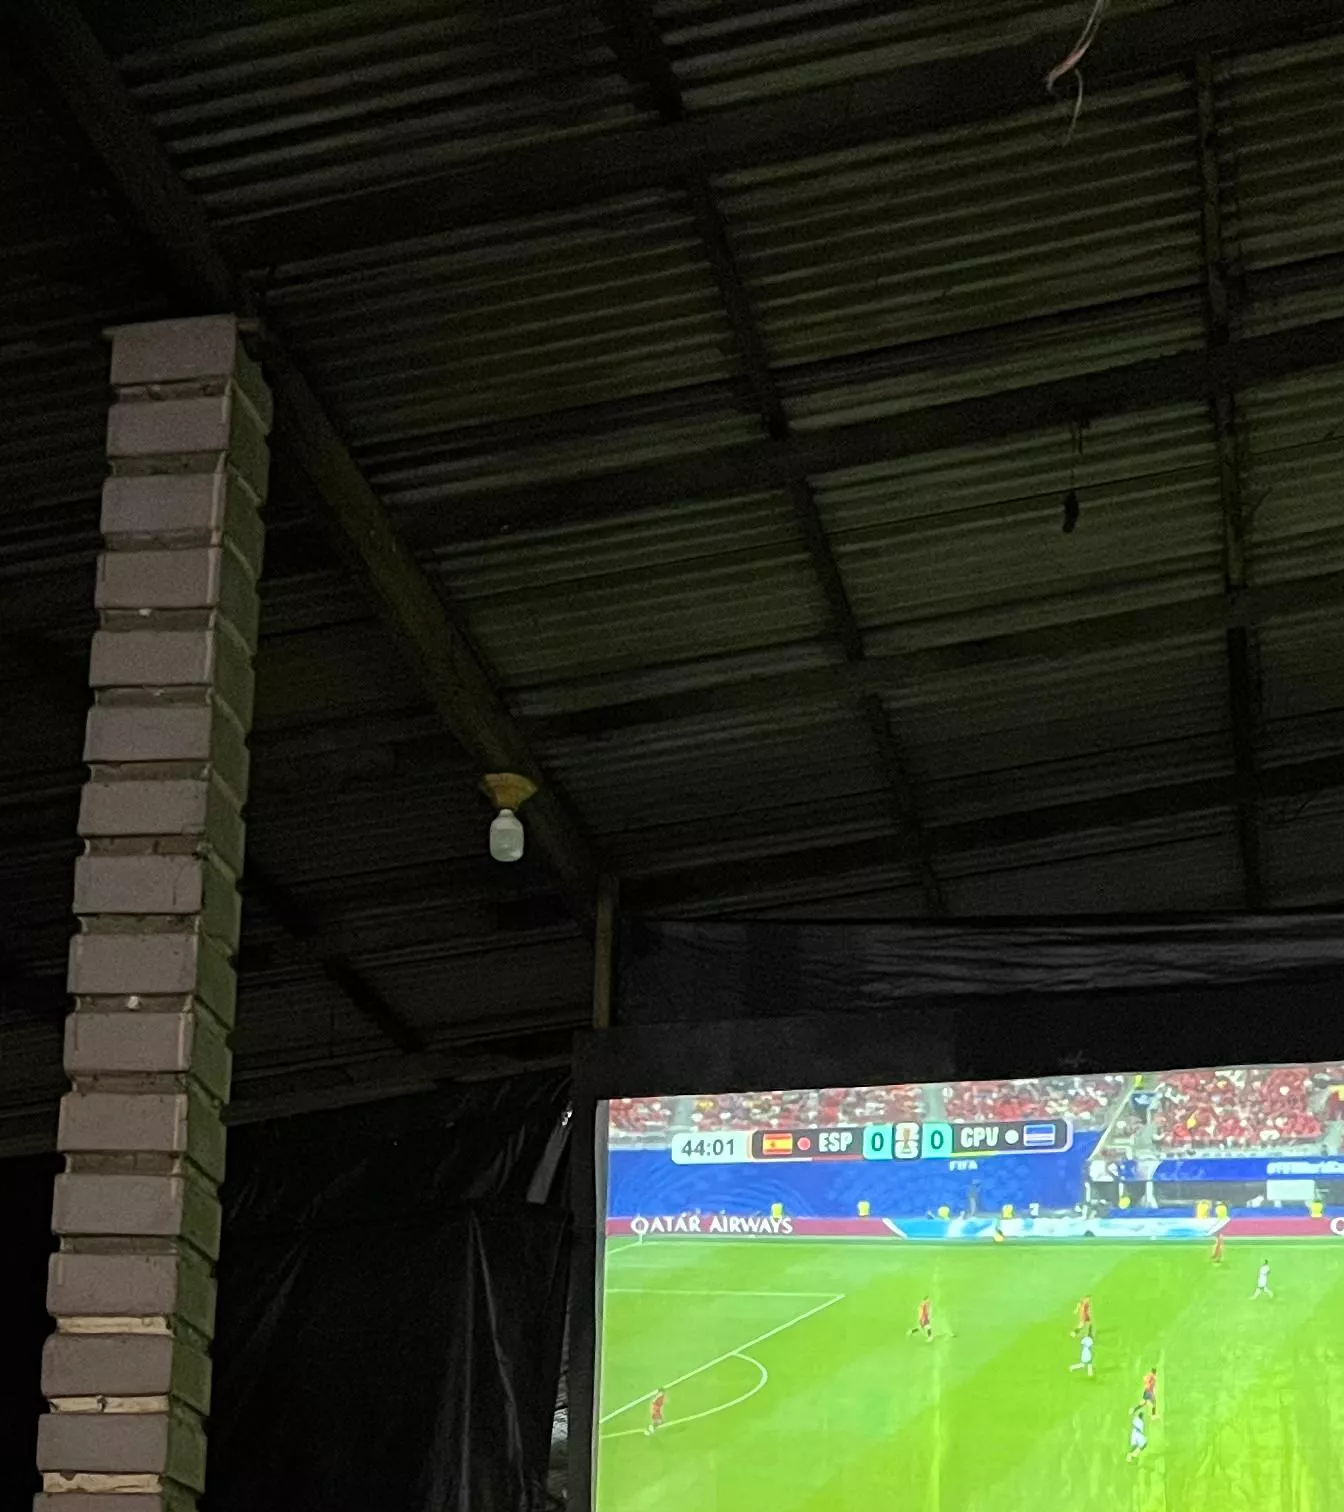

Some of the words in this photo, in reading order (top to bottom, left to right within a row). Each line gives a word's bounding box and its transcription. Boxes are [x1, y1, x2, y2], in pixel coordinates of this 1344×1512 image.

[681, 1138, 734, 1157] 44:01
[818, 1132, 853, 1152] ESP
[871, 1131, 884, 1151] 0
[930, 1130, 944, 1149] 0
[960, 1127, 1000, 1148] CPV
[630, 1213, 702, 1236] QATAR
[709, 1214, 793, 1235] AIRWAYS
